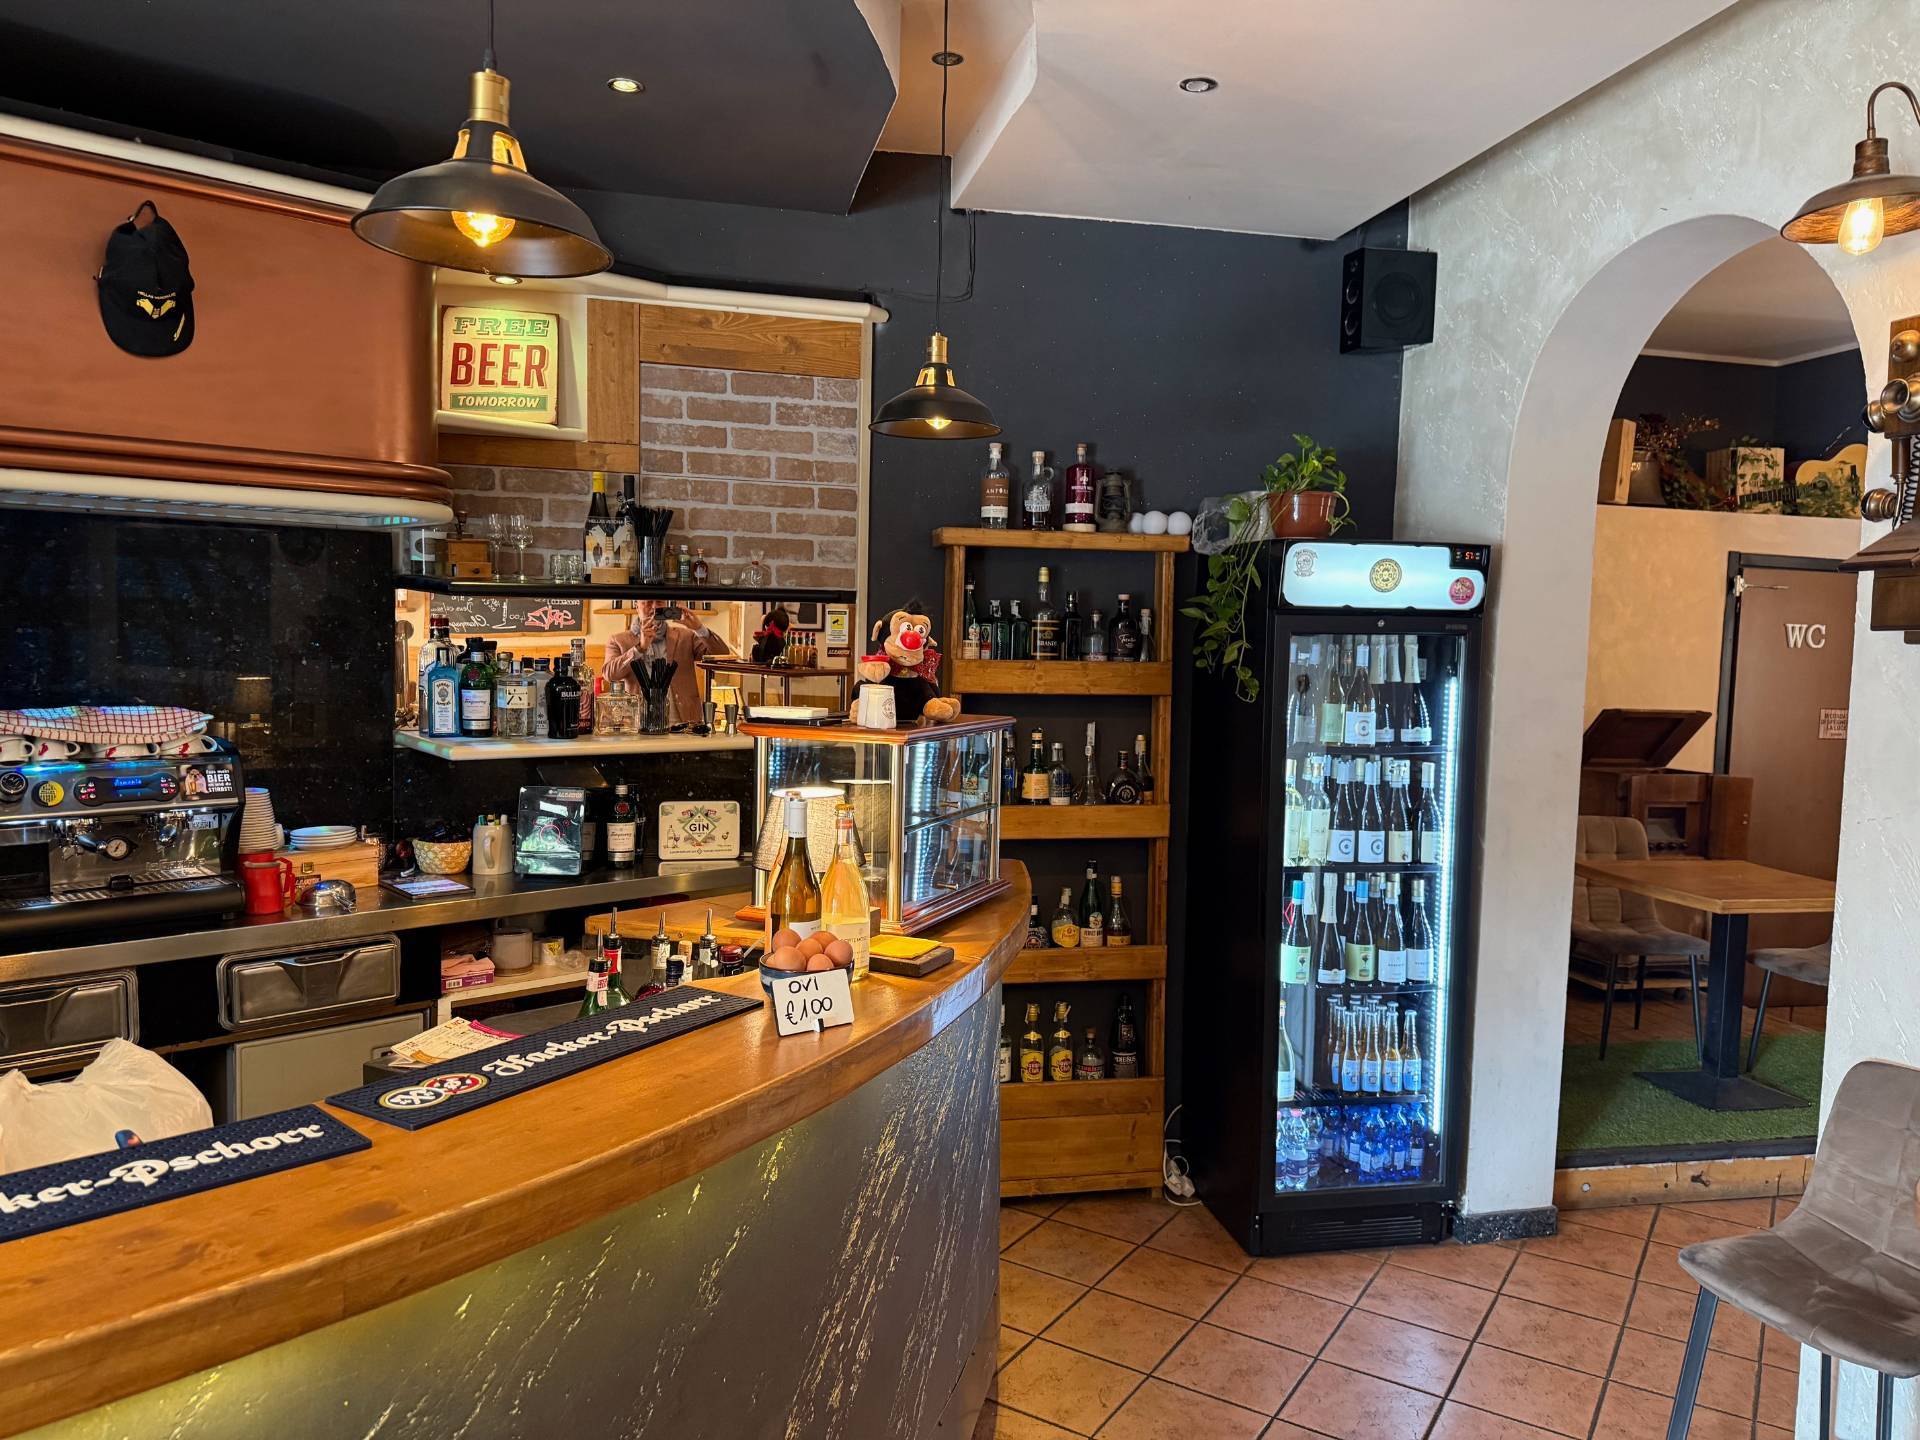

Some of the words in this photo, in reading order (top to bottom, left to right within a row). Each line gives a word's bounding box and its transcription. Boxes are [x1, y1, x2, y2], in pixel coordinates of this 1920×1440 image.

[453, 316, 550, 338] FREE
[450, 342, 549, 388] BEER
[457, 395, 541, 408] TOMORROW
[1784, 623, 1827, 649] WC
[207, 774, 231, 782] BIER
[689, 823, 709, 832] GIN
[788, 976, 819, 994] OVI
[481, 995, 723, 1077] Hacker-Pschorr
